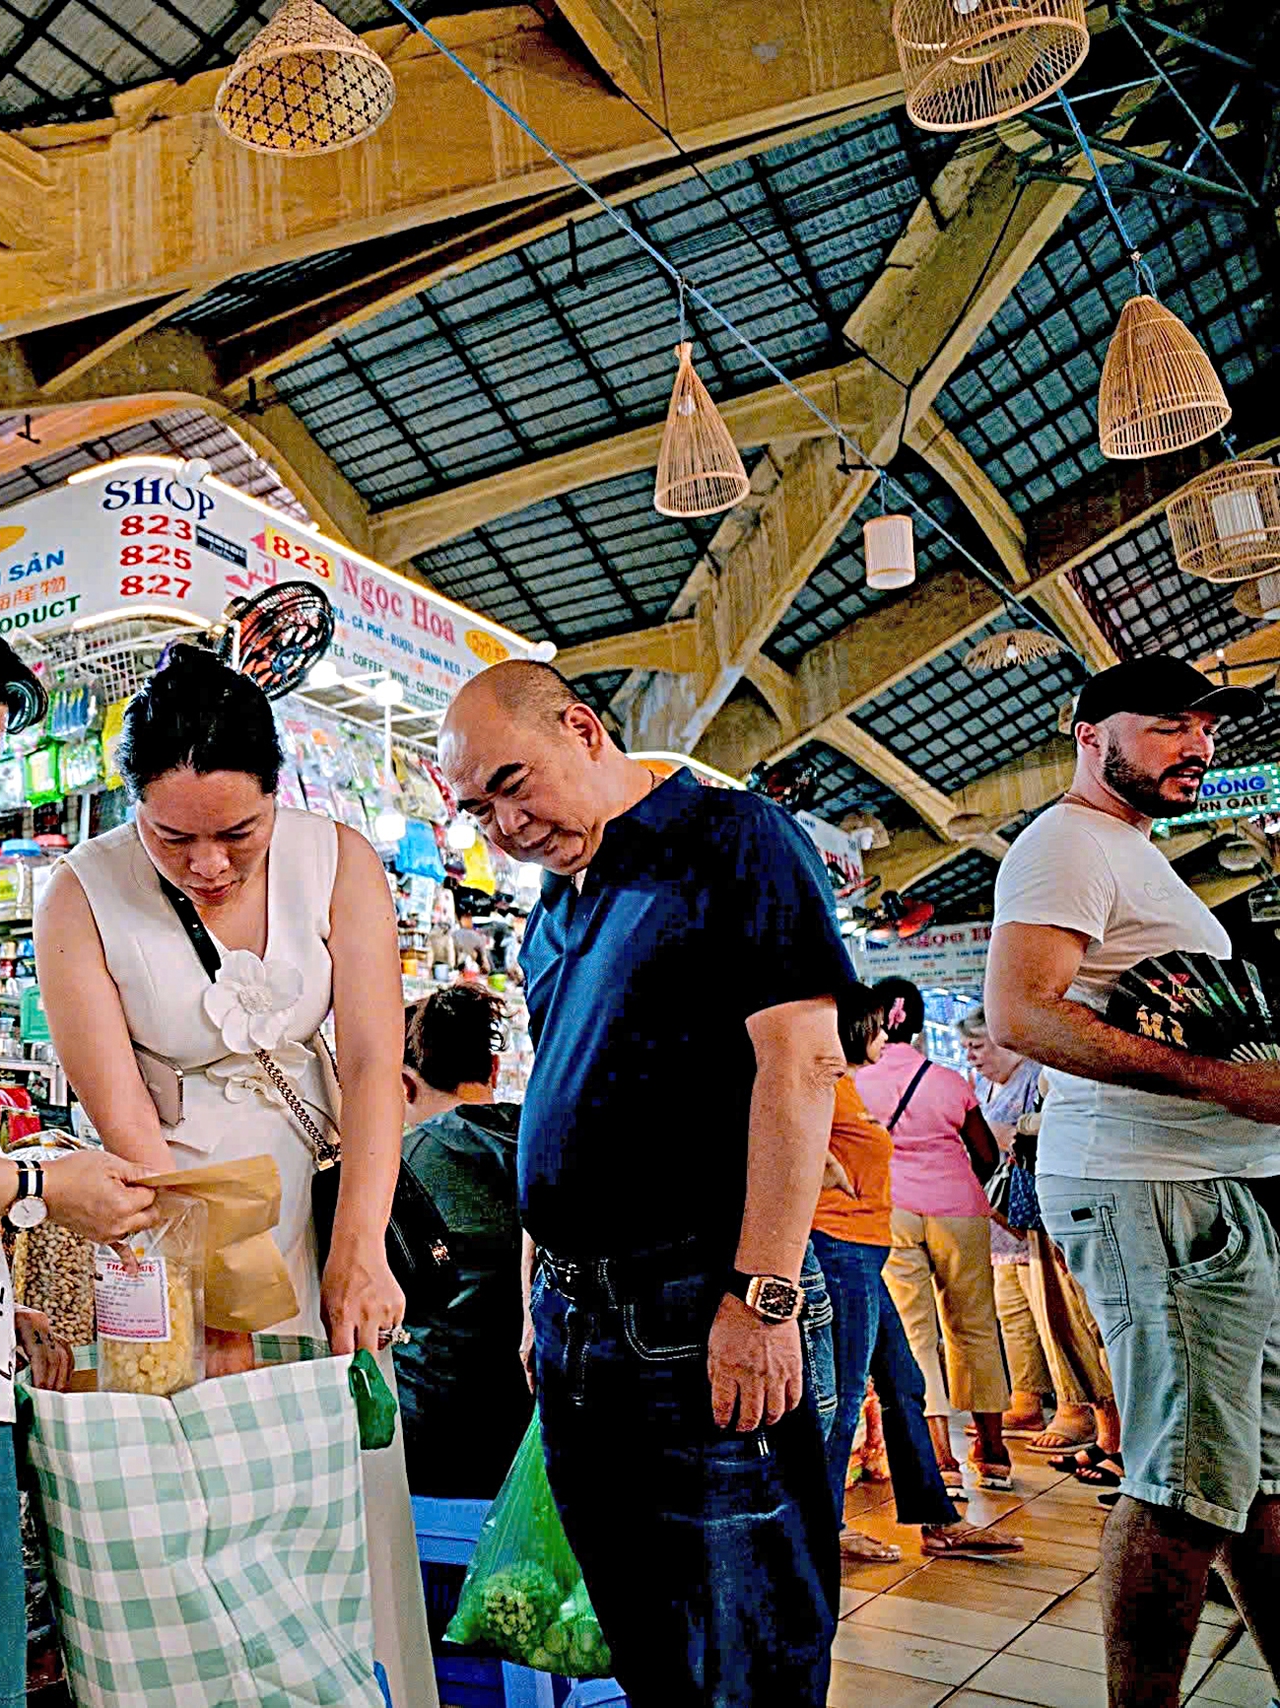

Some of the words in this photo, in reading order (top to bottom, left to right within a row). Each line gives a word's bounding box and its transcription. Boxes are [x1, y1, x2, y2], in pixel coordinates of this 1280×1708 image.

[102, 477, 214, 520] SHOP
[120, 514, 192, 541] 823
[8, 550, 65, 582] SẢN
[120, 544, 192, 570] 825
[273, 535, 331, 579] 823
[120, 574, 192, 600] 827
[341, 557, 404, 619] Ngọc
[411, 594, 457, 647] Hoa
